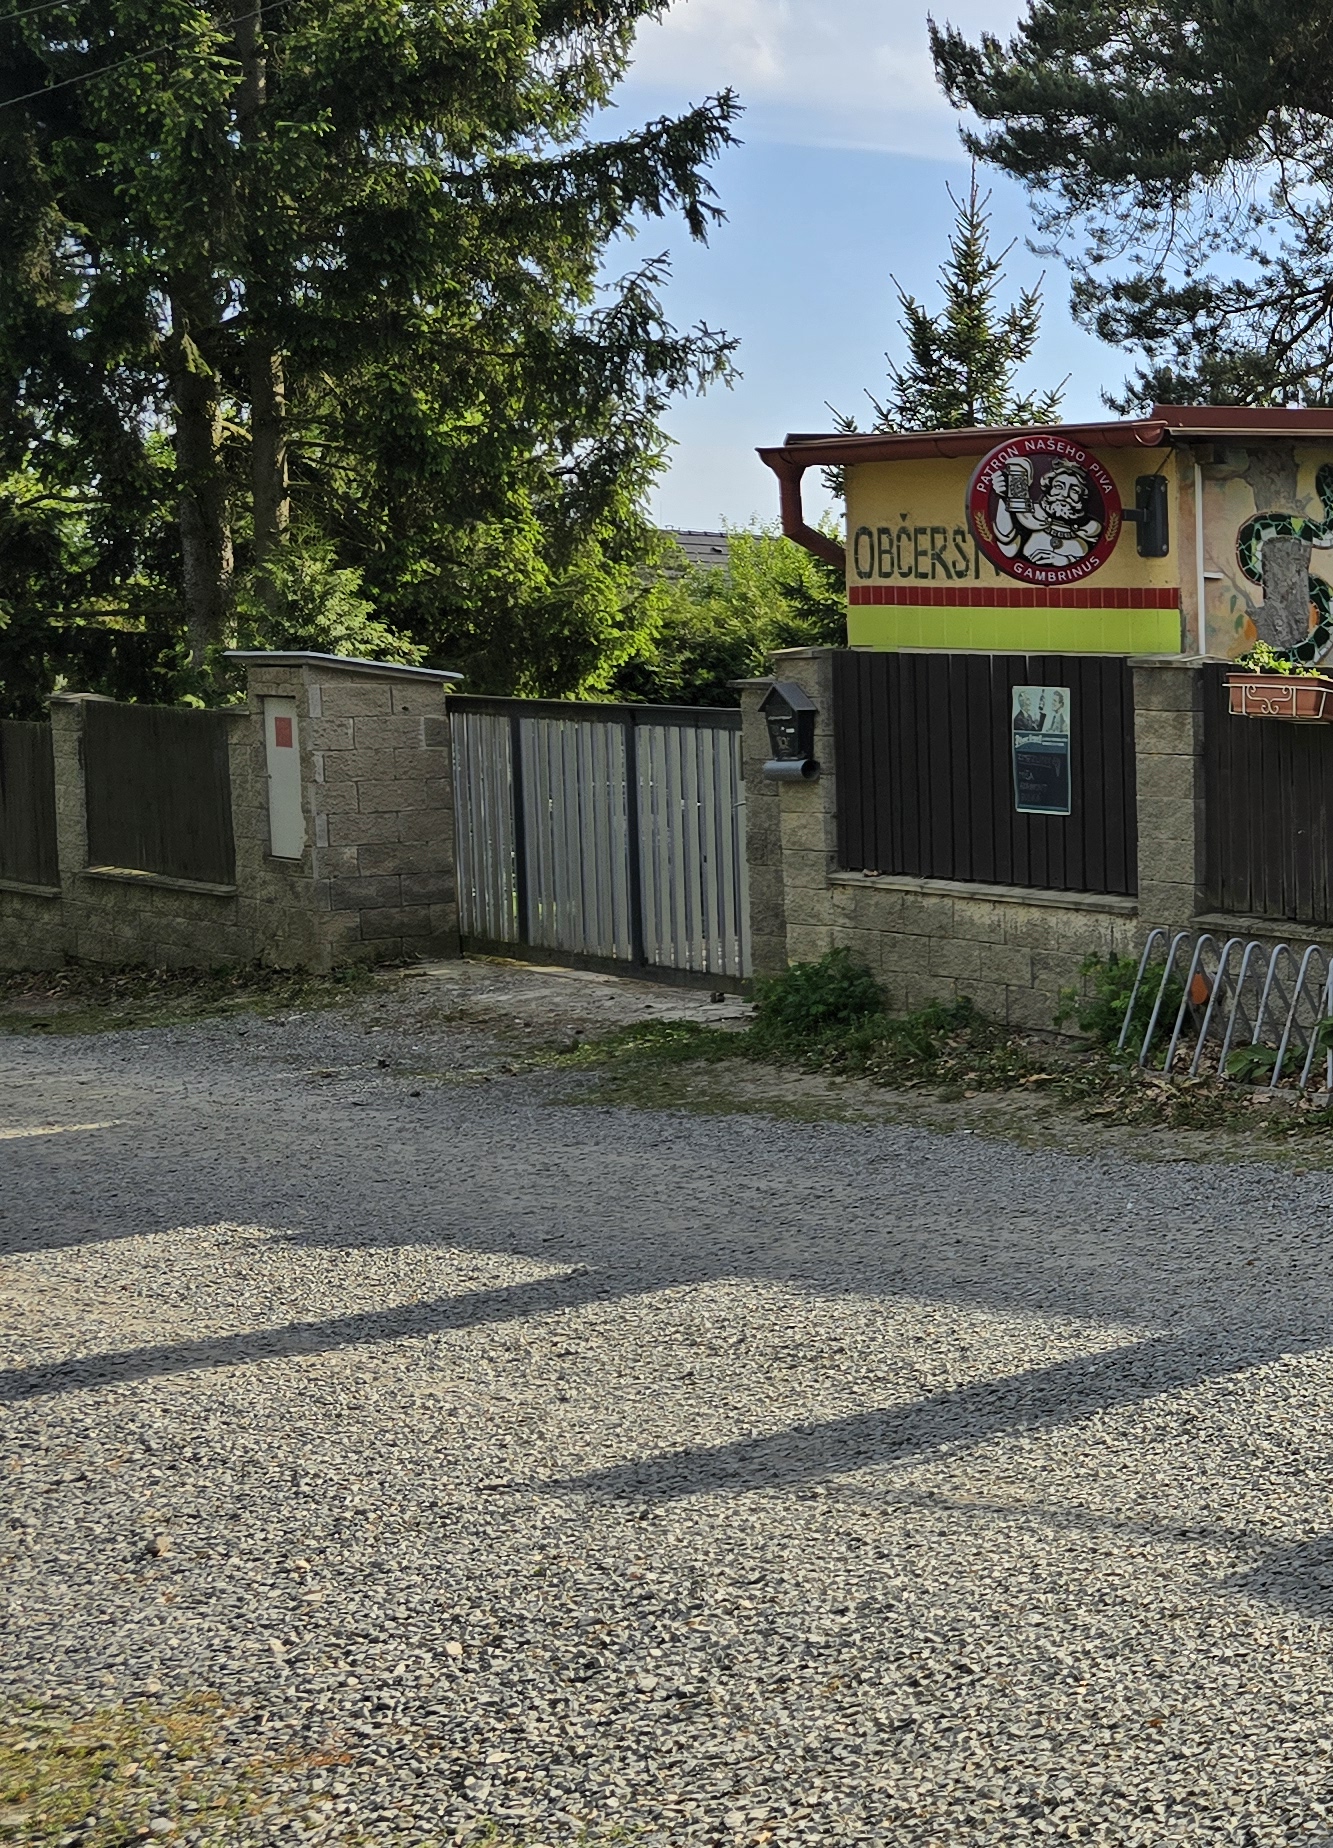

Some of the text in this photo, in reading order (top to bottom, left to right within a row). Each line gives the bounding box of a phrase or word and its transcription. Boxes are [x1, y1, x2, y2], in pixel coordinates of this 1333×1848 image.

[976, 438, 1113, 494] PATRON NAŠEHO PIVA
[1013, 555, 1100, 582] GAMBRINUS
